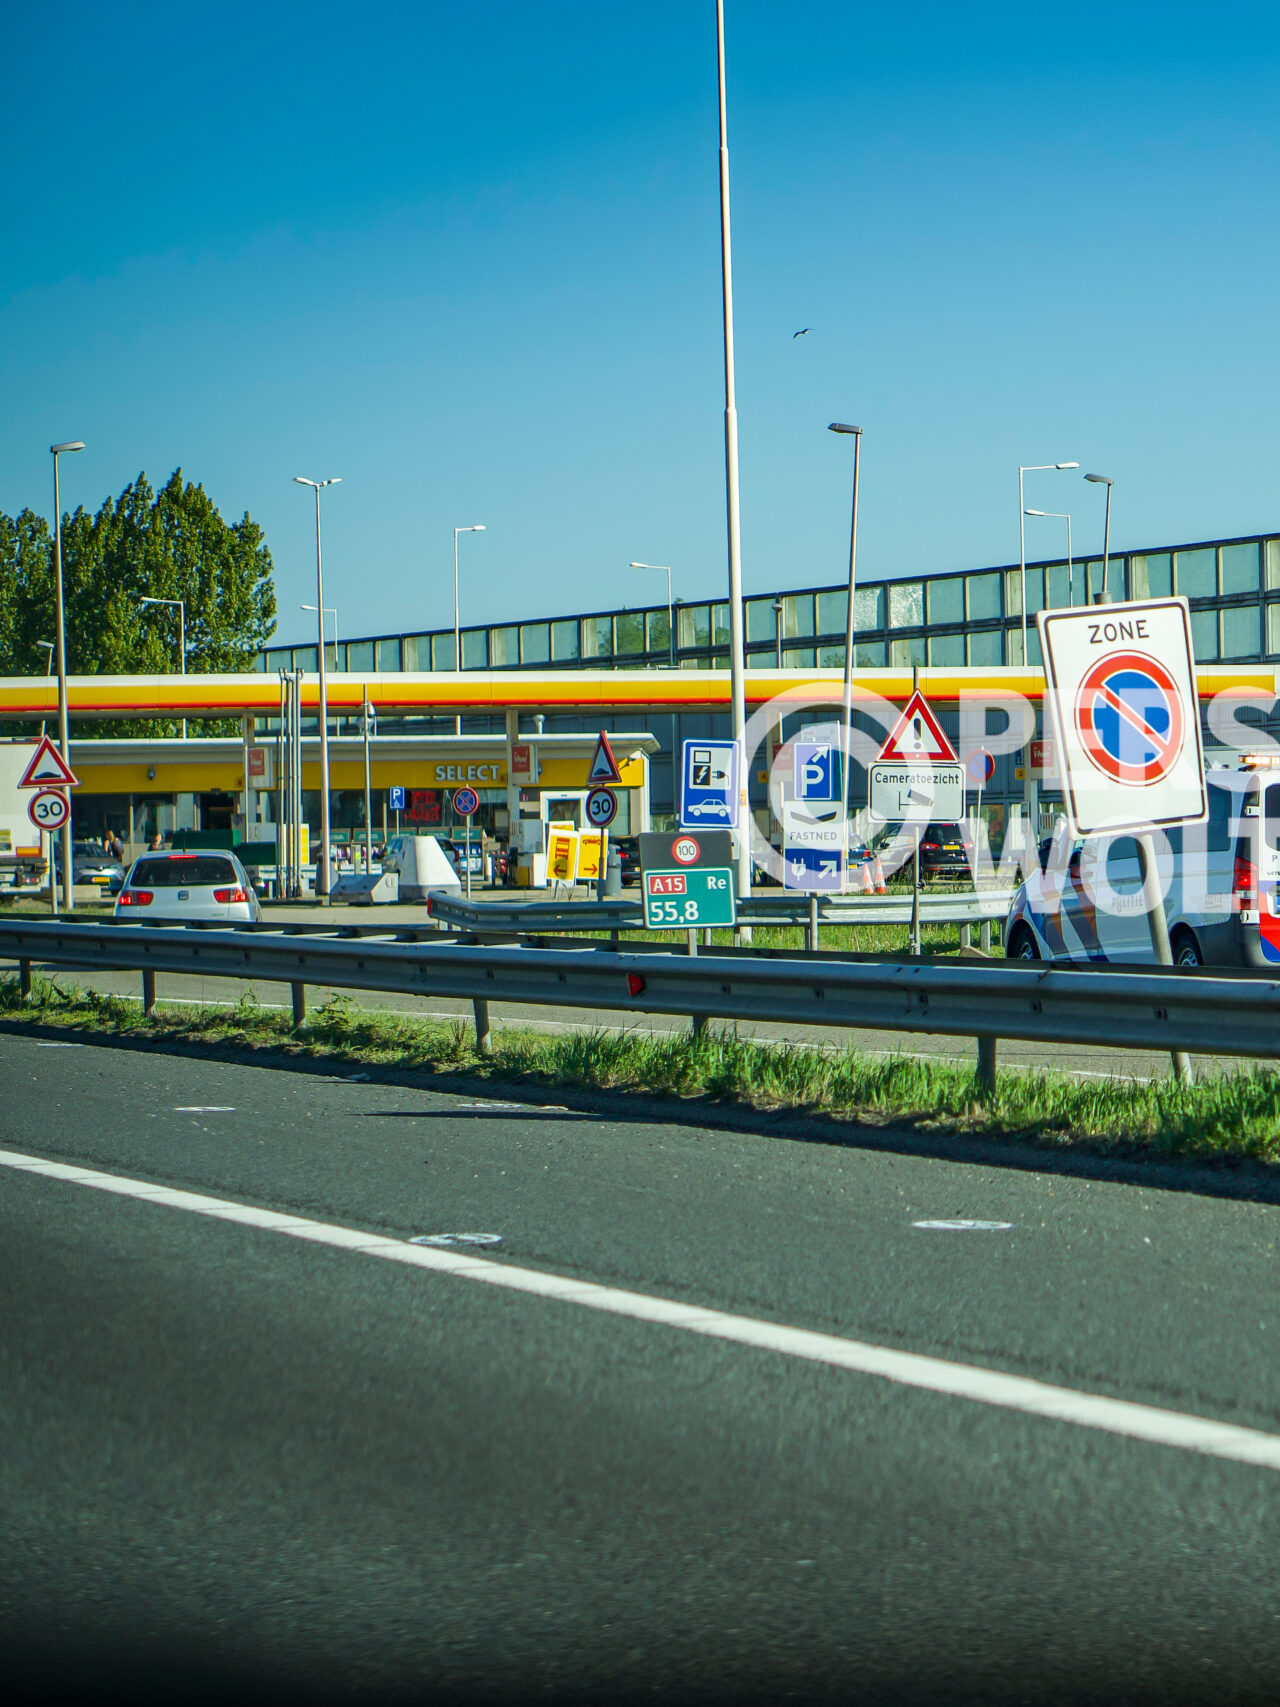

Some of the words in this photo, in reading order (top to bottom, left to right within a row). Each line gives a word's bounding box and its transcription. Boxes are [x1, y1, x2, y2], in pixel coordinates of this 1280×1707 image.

[1088, 619, 1149, 644] ZONE
[435, 765, 499, 781] SELECT
[875, 772, 959, 784] Cameratoezicht
[37, 801, 63, 818] 30
[592, 799, 611, 816] 30
[790, 831, 837, 841] FASTNED
[678, 845, 696, 856] 100
[653, 877, 683, 892] A15
[707, 876, 727, 890] Re
[650, 900, 699, 924] 55,8
